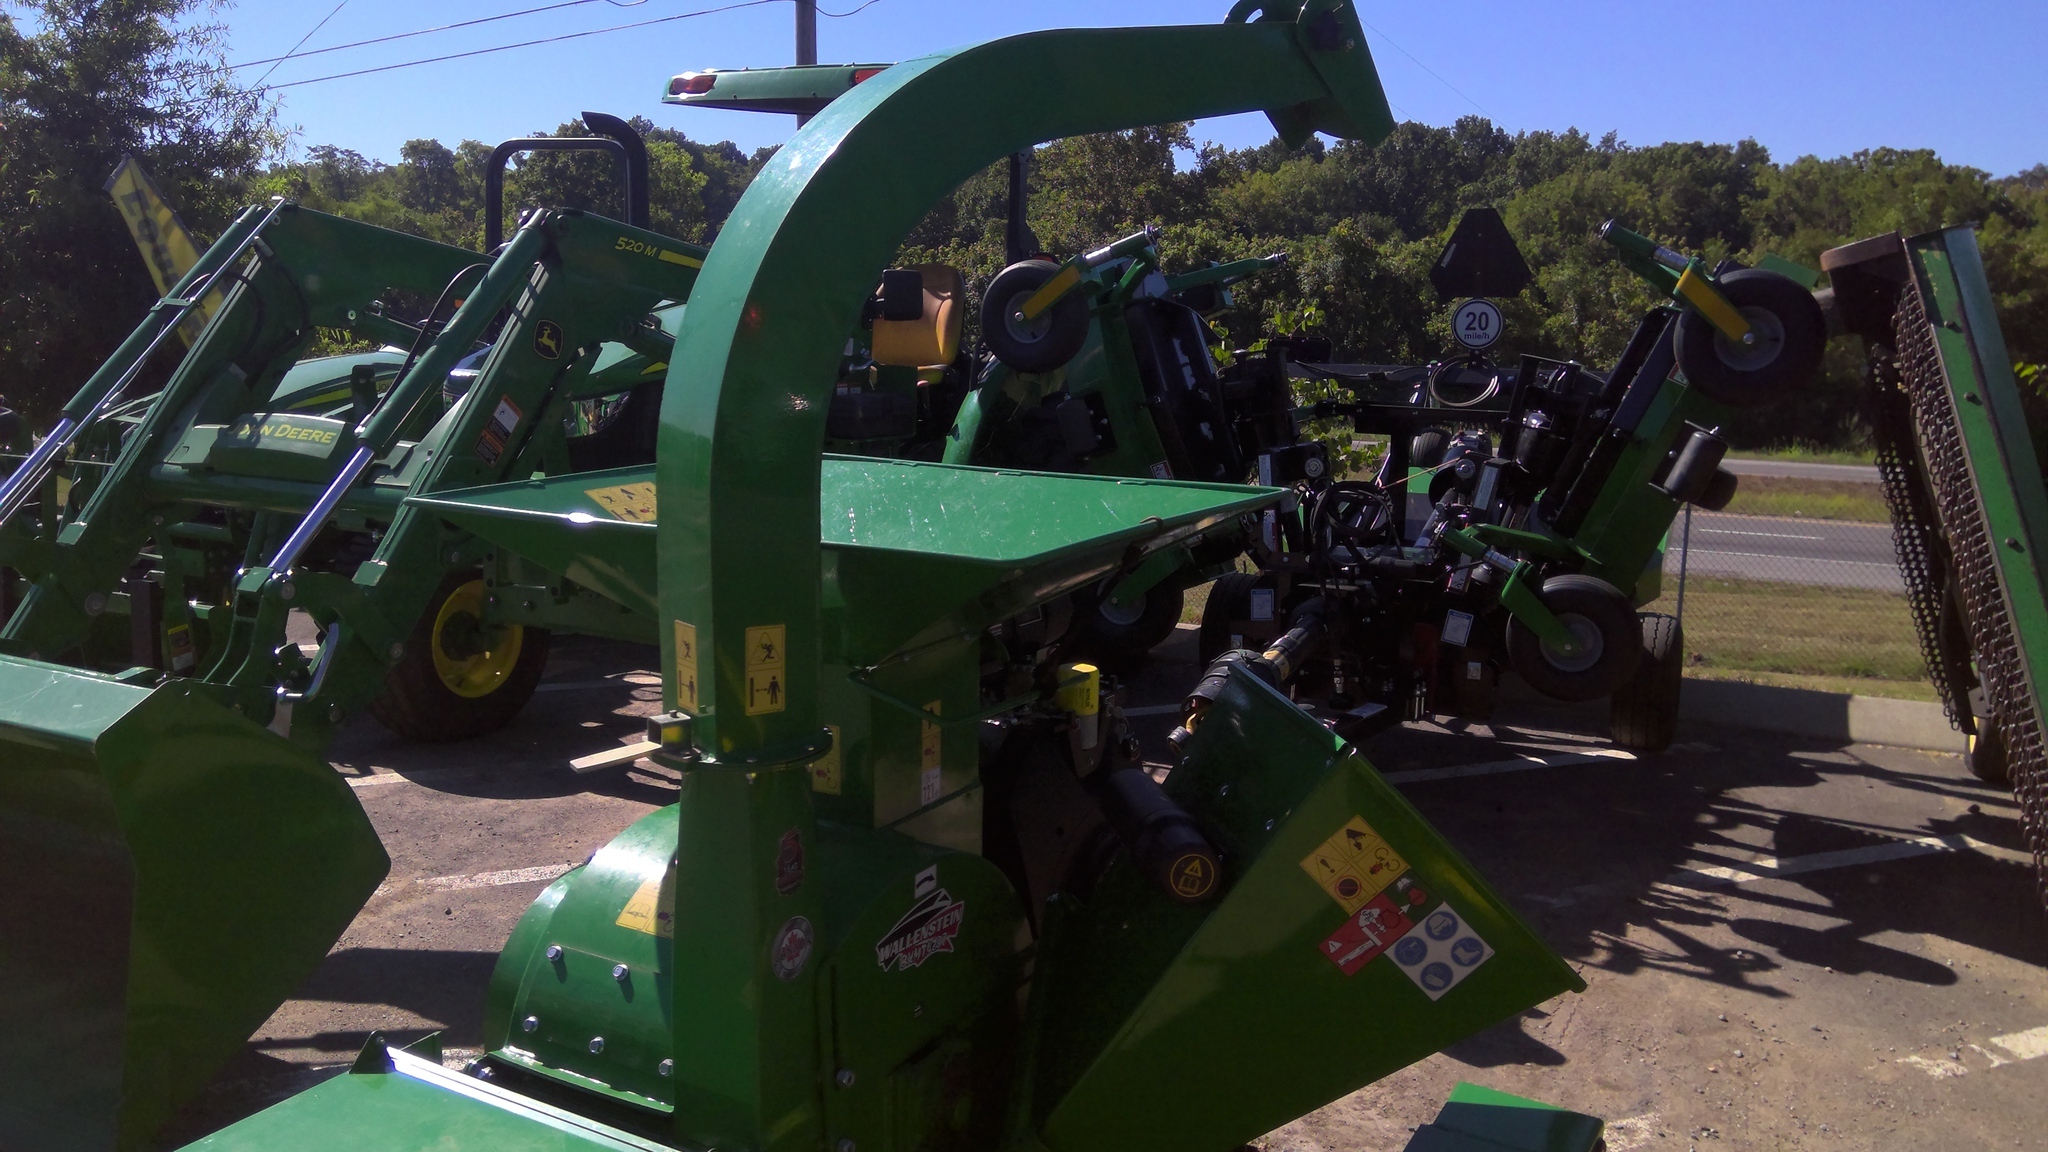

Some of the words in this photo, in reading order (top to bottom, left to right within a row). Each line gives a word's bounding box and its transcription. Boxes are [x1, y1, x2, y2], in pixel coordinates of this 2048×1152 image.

[615, 236, 644, 253] 520
[644, 245, 657, 257] M
[1465, 311, 1489, 331] 20
[1464, 332, 1490, 340] mile/h
[273, 423, 338, 444] DEERE
[878, 908, 962, 962] WALLENSTEIN
